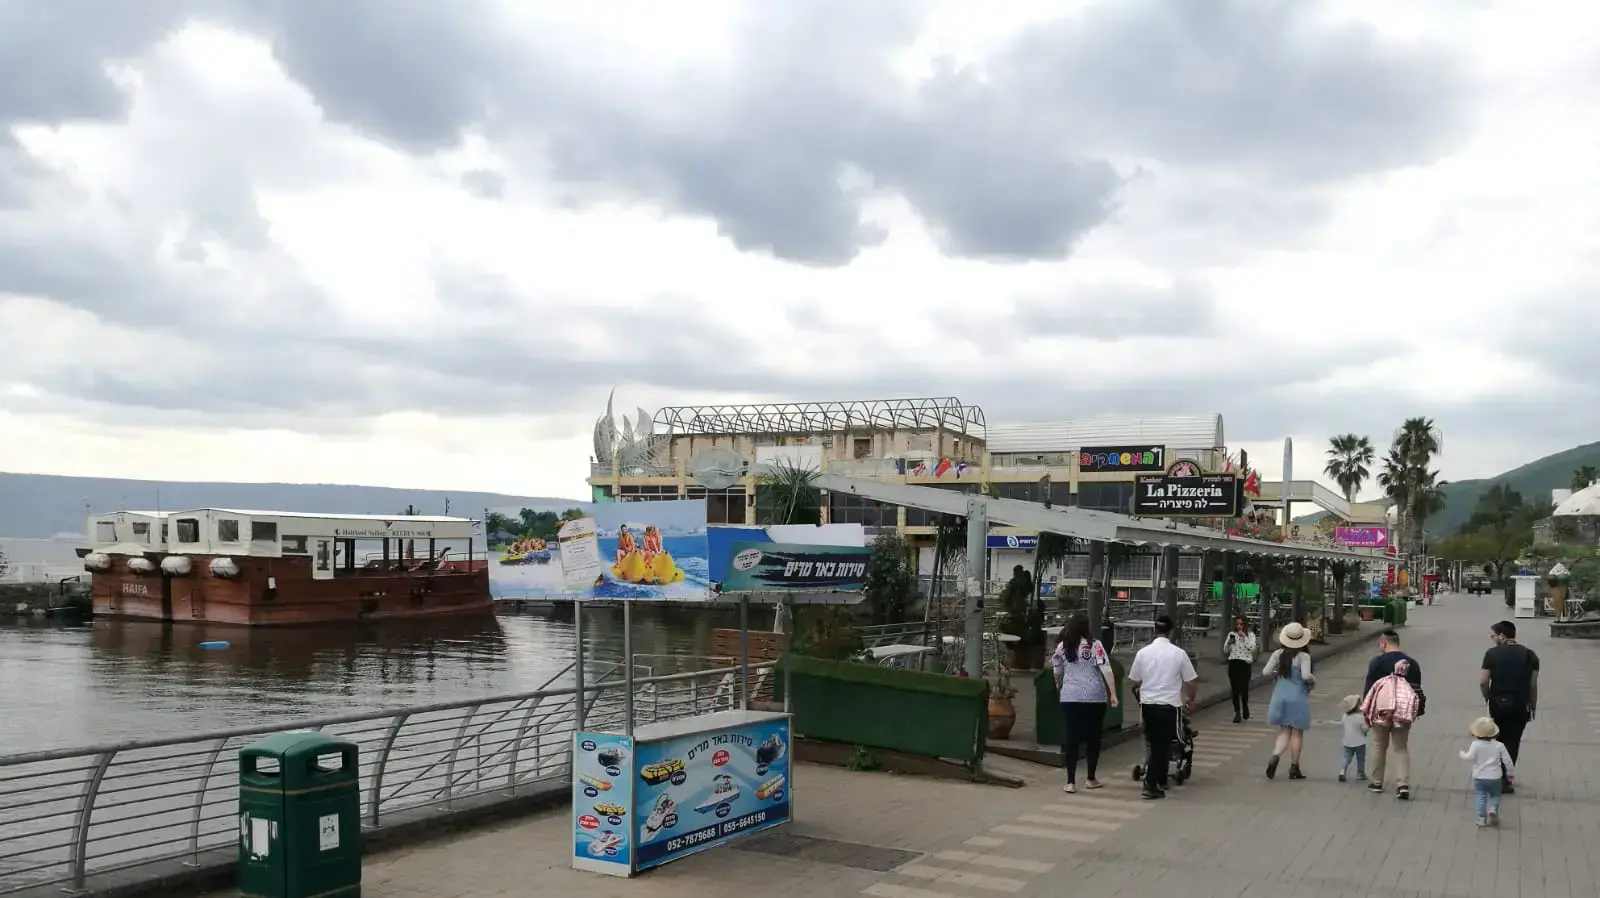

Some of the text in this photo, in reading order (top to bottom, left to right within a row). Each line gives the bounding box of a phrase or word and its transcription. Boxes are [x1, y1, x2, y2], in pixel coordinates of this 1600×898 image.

[1147, 484, 1223, 497] La Pizzeria
[1160, 498, 1208, 509] לה פיצריה
[784, 561, 865, 577] סירות באר מרים
[122, 583, 148, 595] HAIFA
[712, 734, 728, 745] באר
[731, 734, 753, 746] סירות
[688, 740, 709, 760] מרים
[667, 811, 766, 851] 052-7879688 055-6645150
